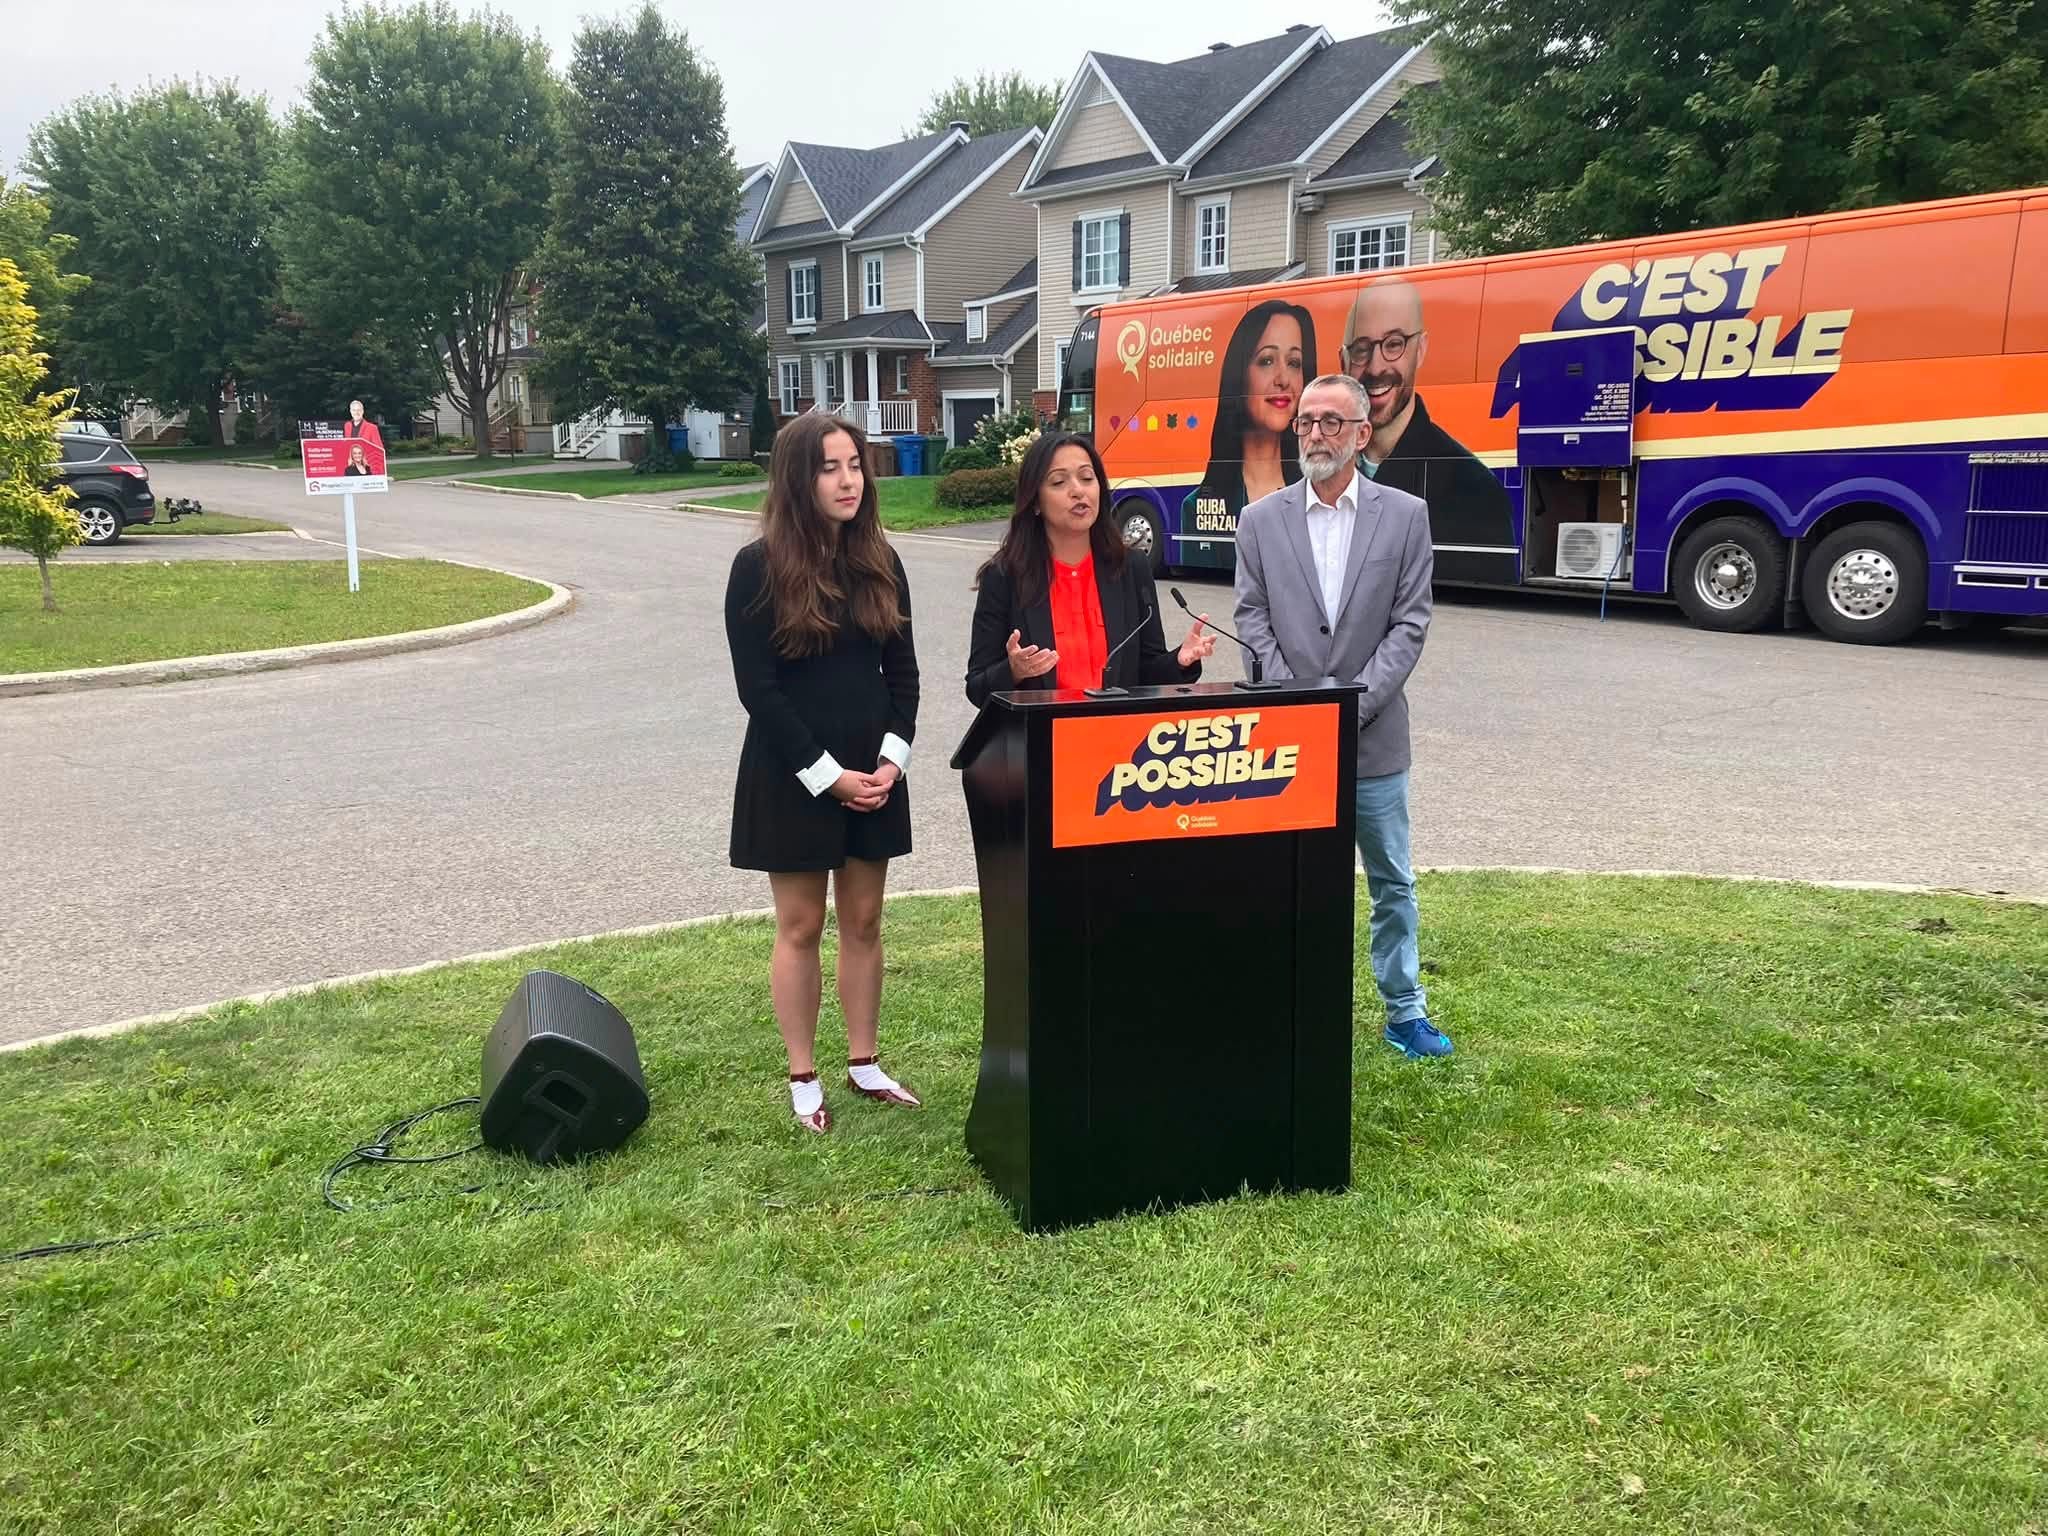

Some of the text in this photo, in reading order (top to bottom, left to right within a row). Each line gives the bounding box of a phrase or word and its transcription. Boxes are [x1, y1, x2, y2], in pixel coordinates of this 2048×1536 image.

[1580, 245, 1787, 321] C'EST
[1081, 331, 1095, 341] 7144
[1150, 324, 1212, 346] Québec
[1634, 309, 1853, 382] SIBLE
[1148, 346, 1215, 369] solidaire
[1196, 498, 1226, 514] RUBA
[1147, 712, 1260, 755] C'EST
[1110, 744, 1299, 797] POSSIBLE
